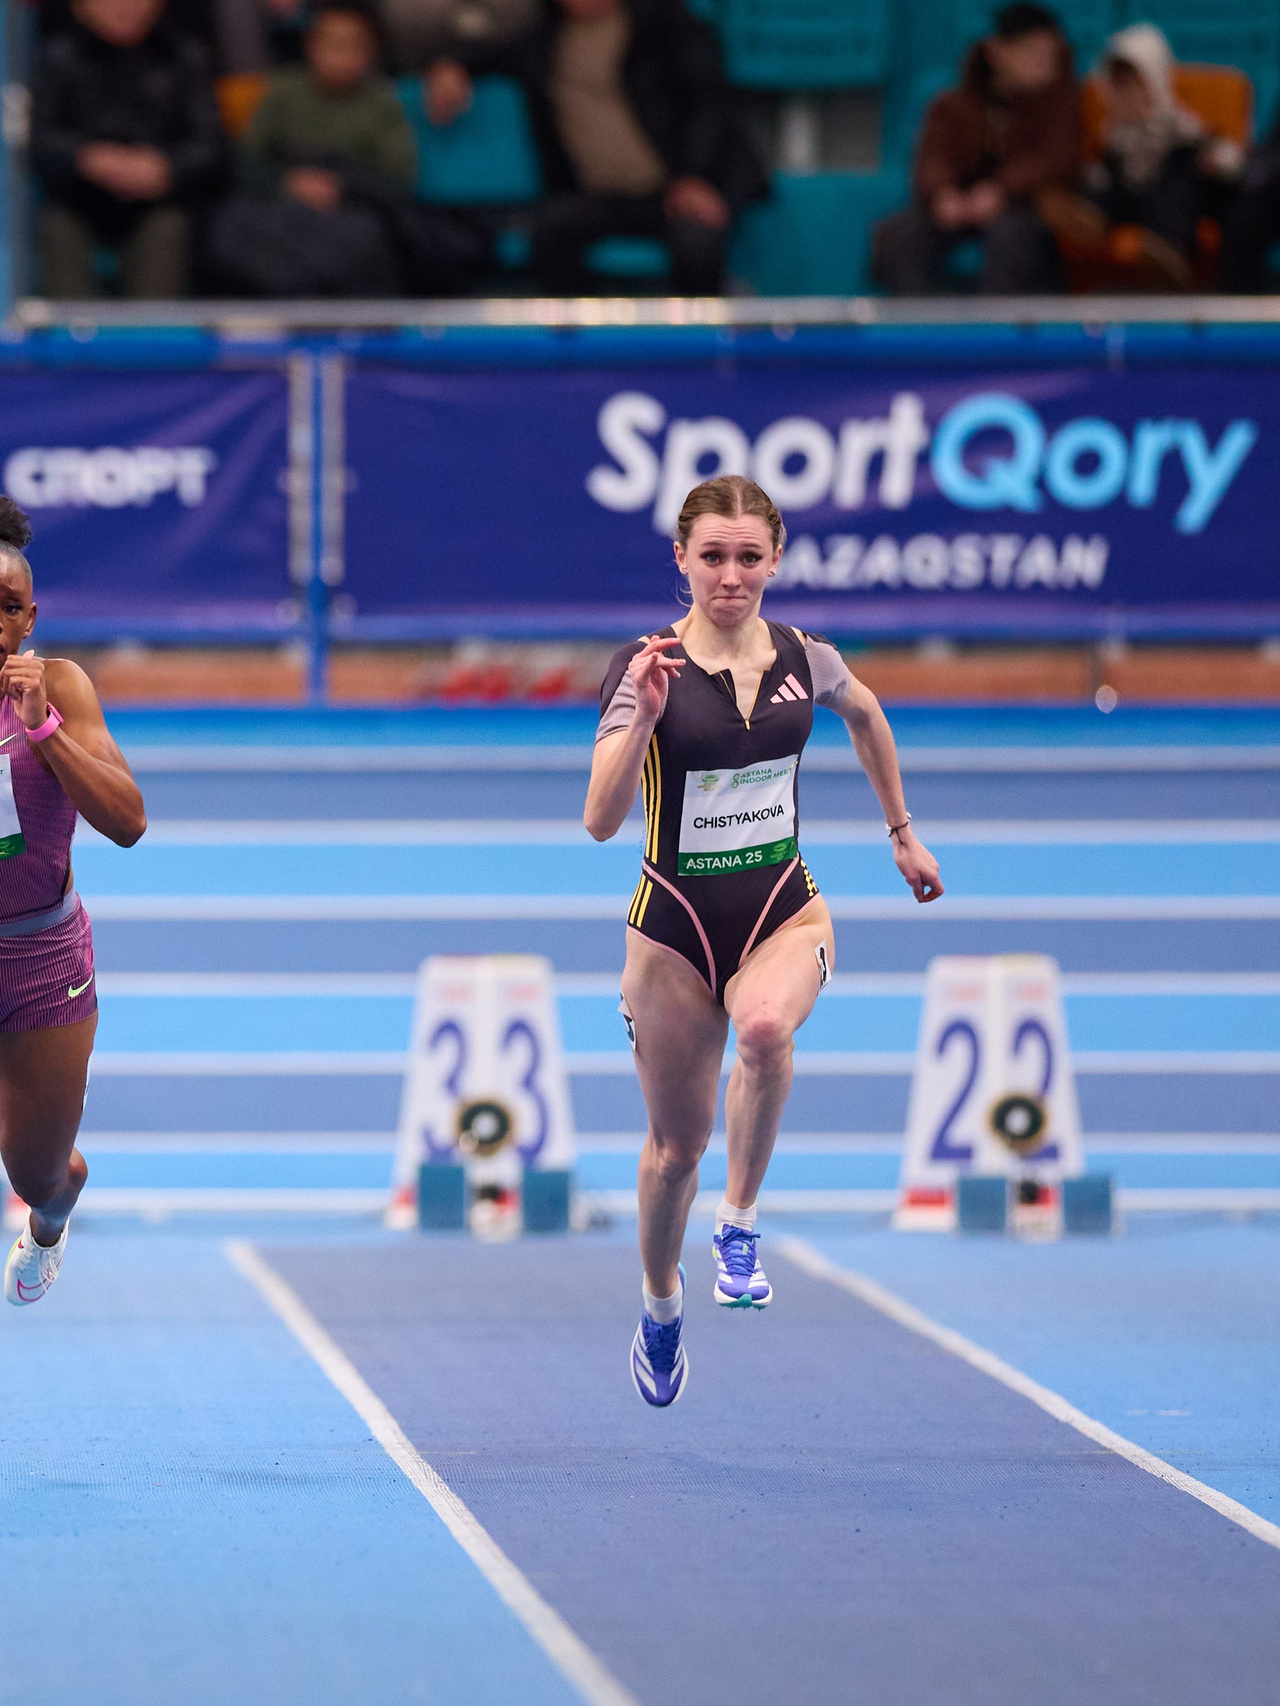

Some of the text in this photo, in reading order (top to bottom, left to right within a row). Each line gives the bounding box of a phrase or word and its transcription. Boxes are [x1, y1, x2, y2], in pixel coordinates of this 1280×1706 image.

[4, 446, 216, 508] СПОРТ
[586, 391, 1258, 535] SportQory
[766, 533, 1109, 590] AZAQSTAN
[740, 767, 793, 785] INDOOR MEET
[741, 768, 772, 778] ASTANA
[693, 804, 785, 829] CHISTYAKOVA
[686, 854, 743, 870] ASTANA
[745, 850, 763, 864] 25
[500, 1019, 549, 1163] 3
[931, 1019, 980, 1161] 2
